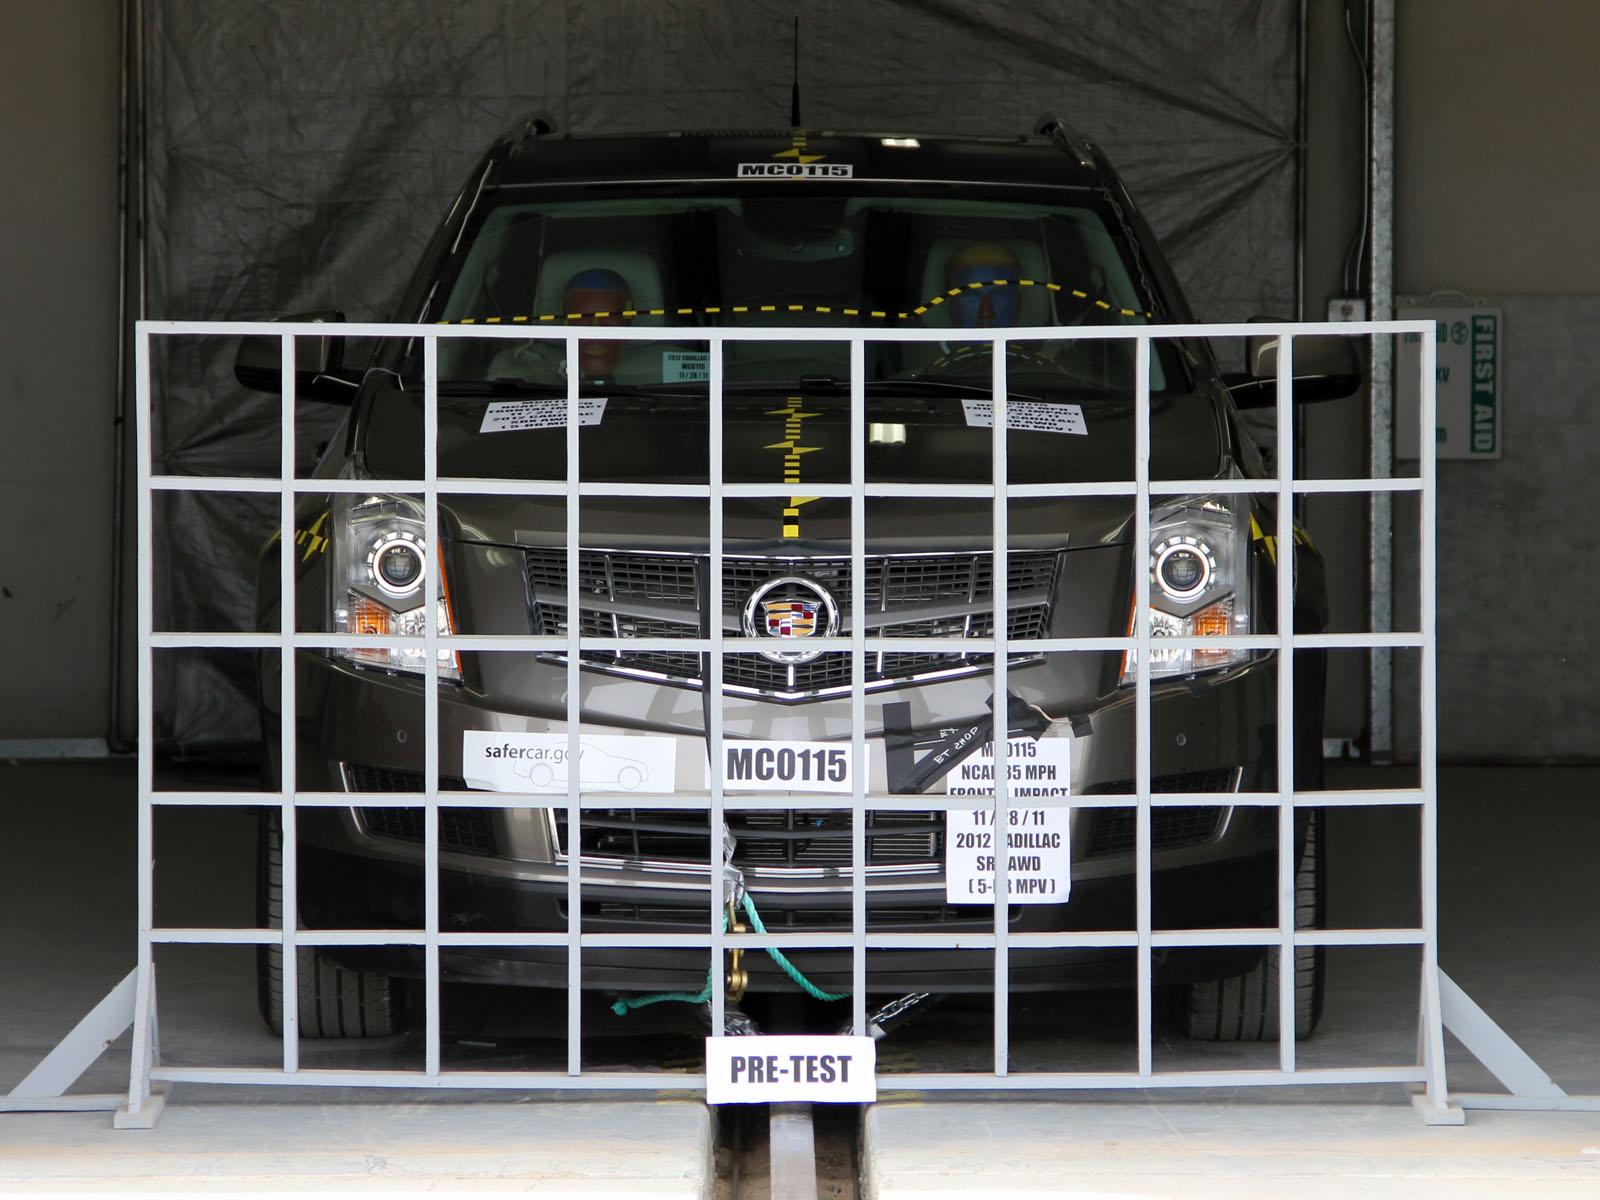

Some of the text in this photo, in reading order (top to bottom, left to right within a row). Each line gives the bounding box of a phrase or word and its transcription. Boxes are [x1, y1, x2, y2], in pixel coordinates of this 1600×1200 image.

[742, 164, 848, 176] MC0115
[1475, 318, 1494, 450] FIRST AID
[981, 742, 1037, 757] M0115
[727, 747, 847, 782] MC0115
[1025, 765, 1056, 780] MPH
[956, 833, 1061, 848] 2012 ADILLAC
[976, 856, 1041, 871] SR AWD
[1016, 879, 1047, 894] MPV
[730, 1055, 852, 1083] PRE-TEST
